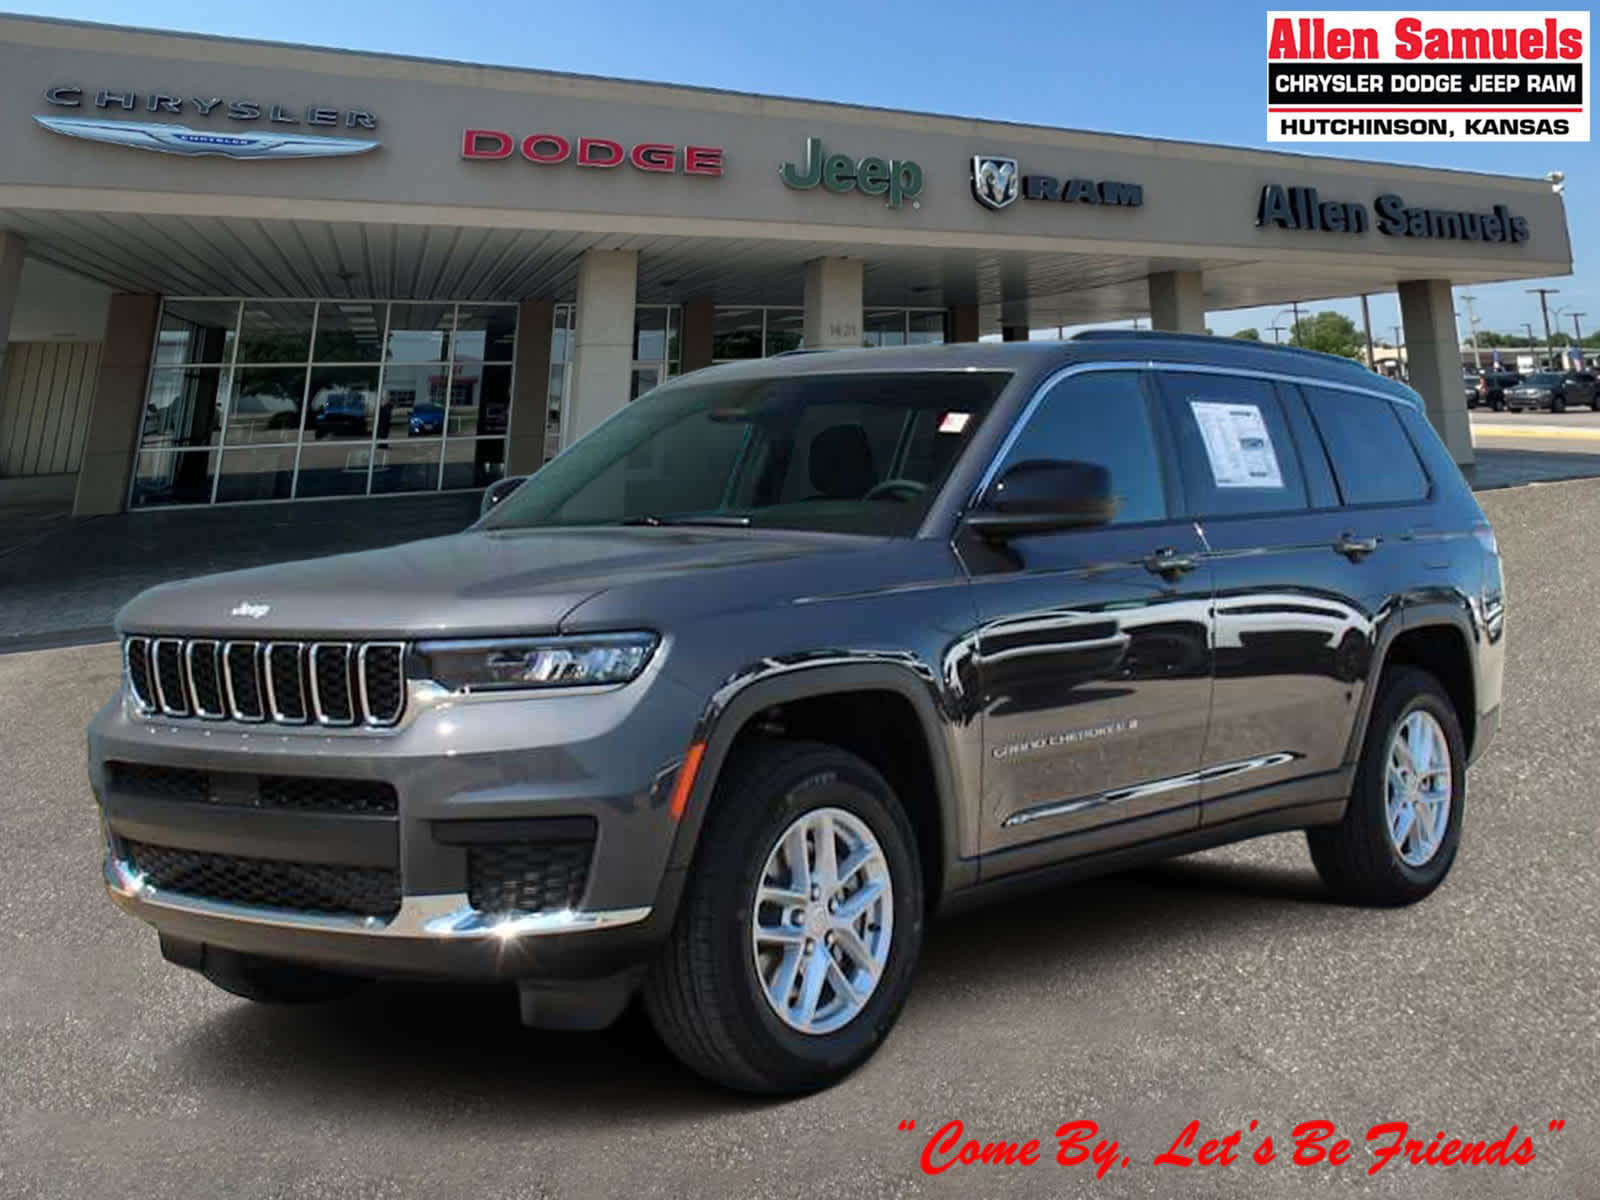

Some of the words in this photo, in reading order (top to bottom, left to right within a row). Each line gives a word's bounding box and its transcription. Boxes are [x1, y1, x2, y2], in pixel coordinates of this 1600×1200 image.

[45, 85, 378, 128] CHRYSLER
[461, 128, 725, 177] DODGE
[779, 136, 924, 209] Jeep
[1023, 175, 1144, 207] RAM
[1255, 184, 1369, 233] Allen
[1374, 193, 1530, 243] Samuels
